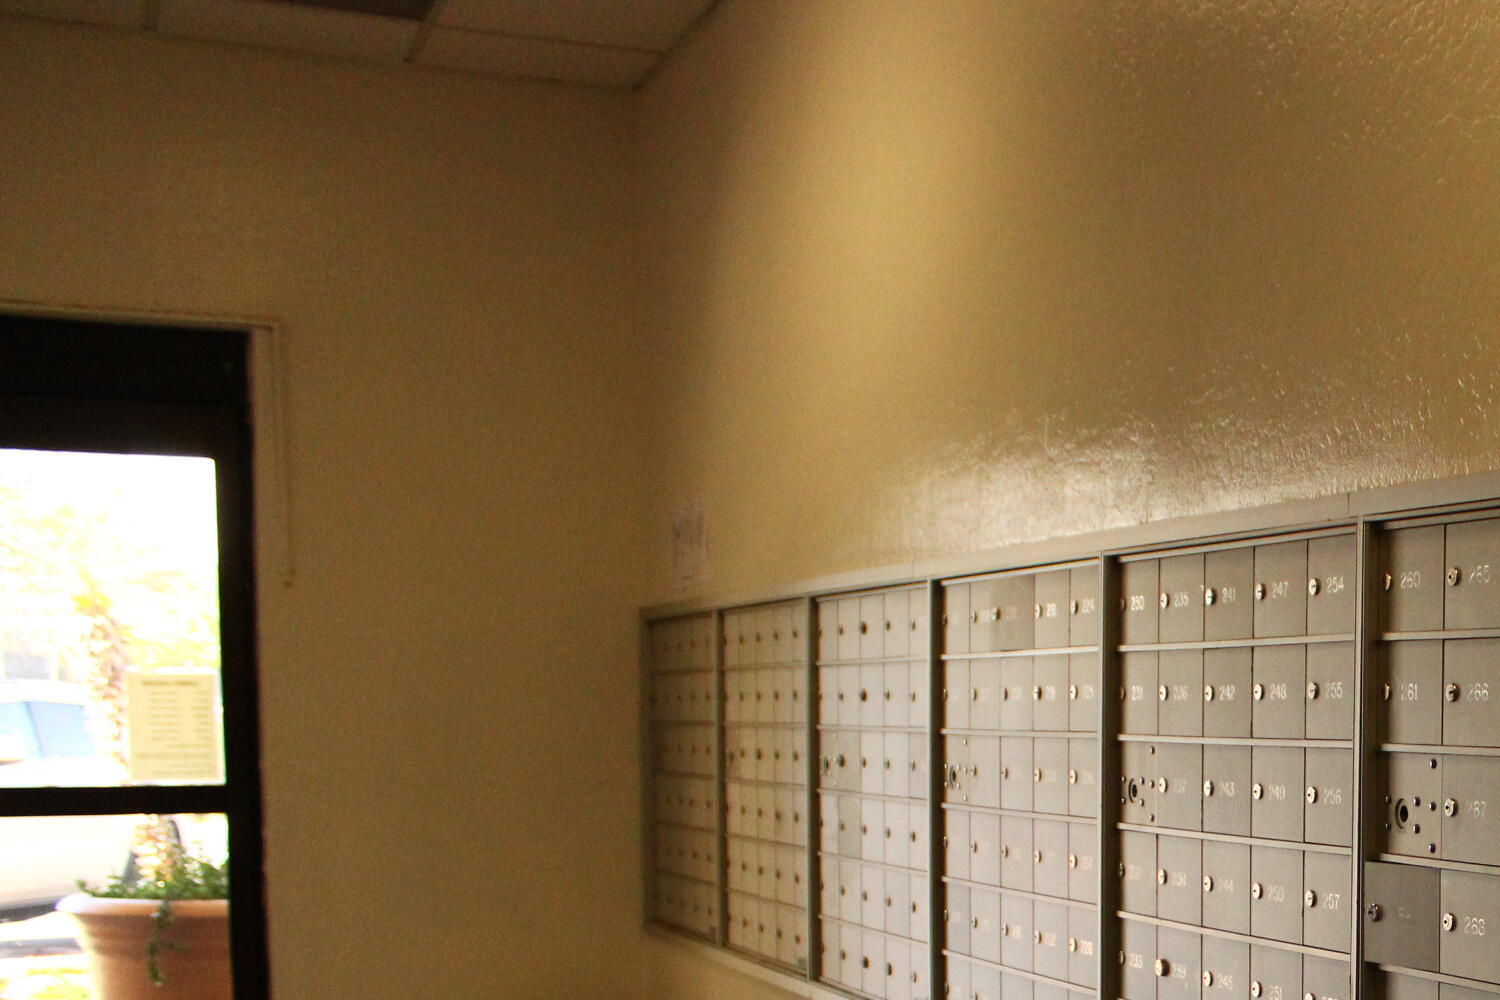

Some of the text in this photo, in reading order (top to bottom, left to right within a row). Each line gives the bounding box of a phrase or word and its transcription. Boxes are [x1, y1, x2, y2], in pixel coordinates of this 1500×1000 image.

[1272, 581, 1289, 599] 247
[1327, 576, 1344, 593] 254
[1223, 587, 1236, 603] 241
[1220, 684, 1235, 701] 242
[1270, 684, 1287, 700] 248
[1325, 682, 1343, 698] 255
[1468, 682, 1489, 701] 266
[1324, 788, 1342, 804] 256
[1323, 893, 1340, 910] 257
